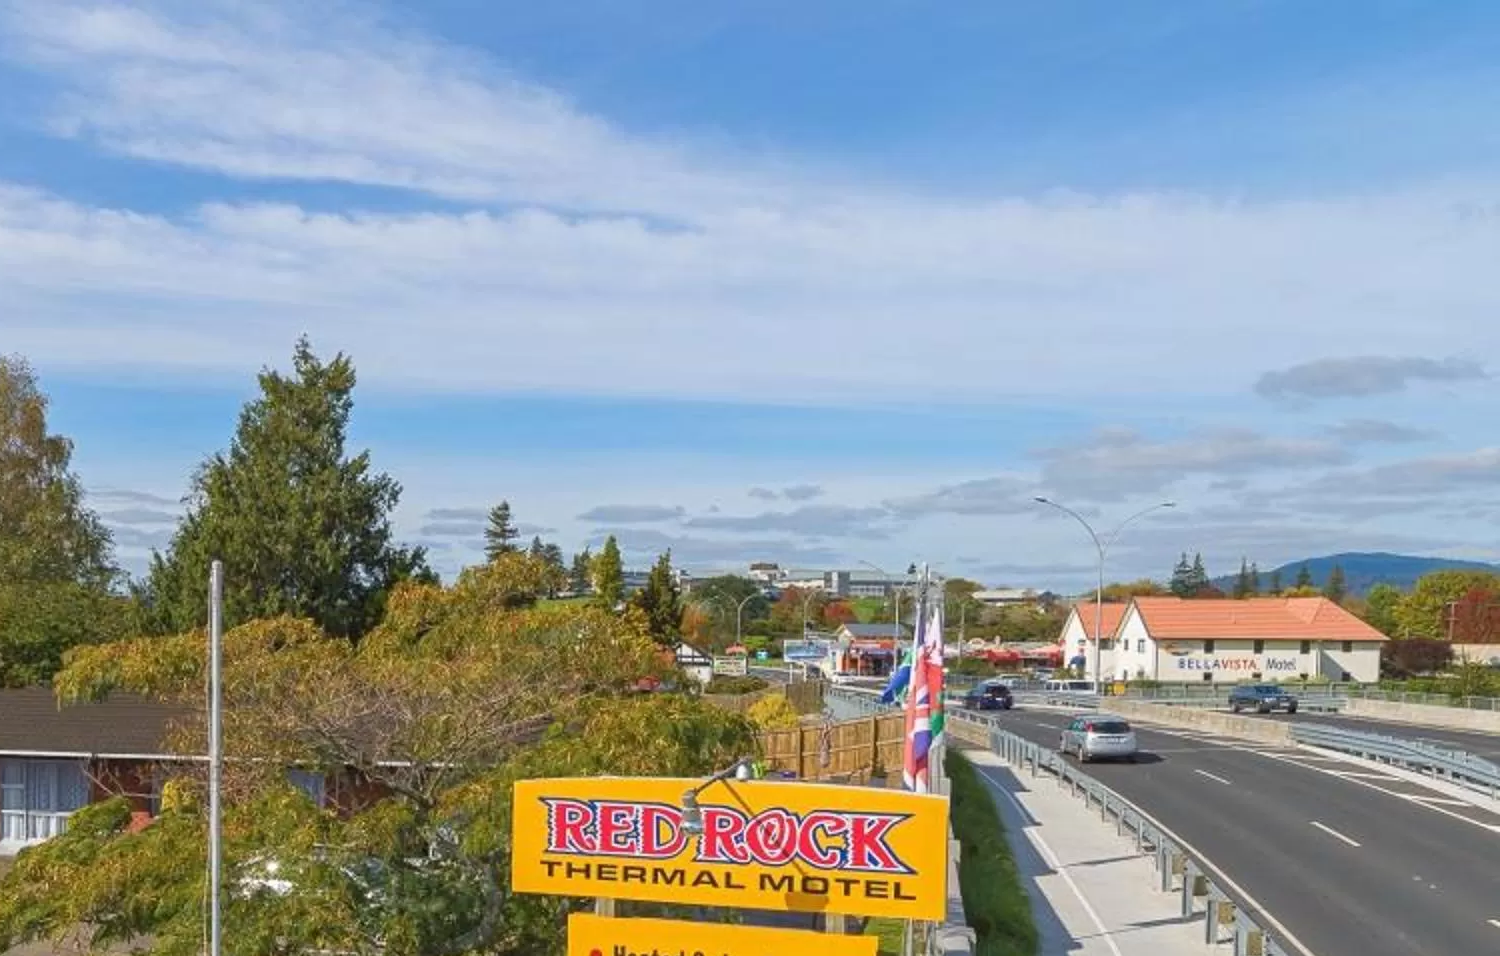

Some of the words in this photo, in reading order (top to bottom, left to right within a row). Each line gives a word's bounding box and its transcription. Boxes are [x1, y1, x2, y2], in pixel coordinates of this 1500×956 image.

[1266, 657, 1297, 671] Motel
[539, 796, 690, 859] RED
[694, 804, 919, 876] ROCK
[540, 860, 745, 889] THERMAL
[759, 873, 918, 901] MOTEL
